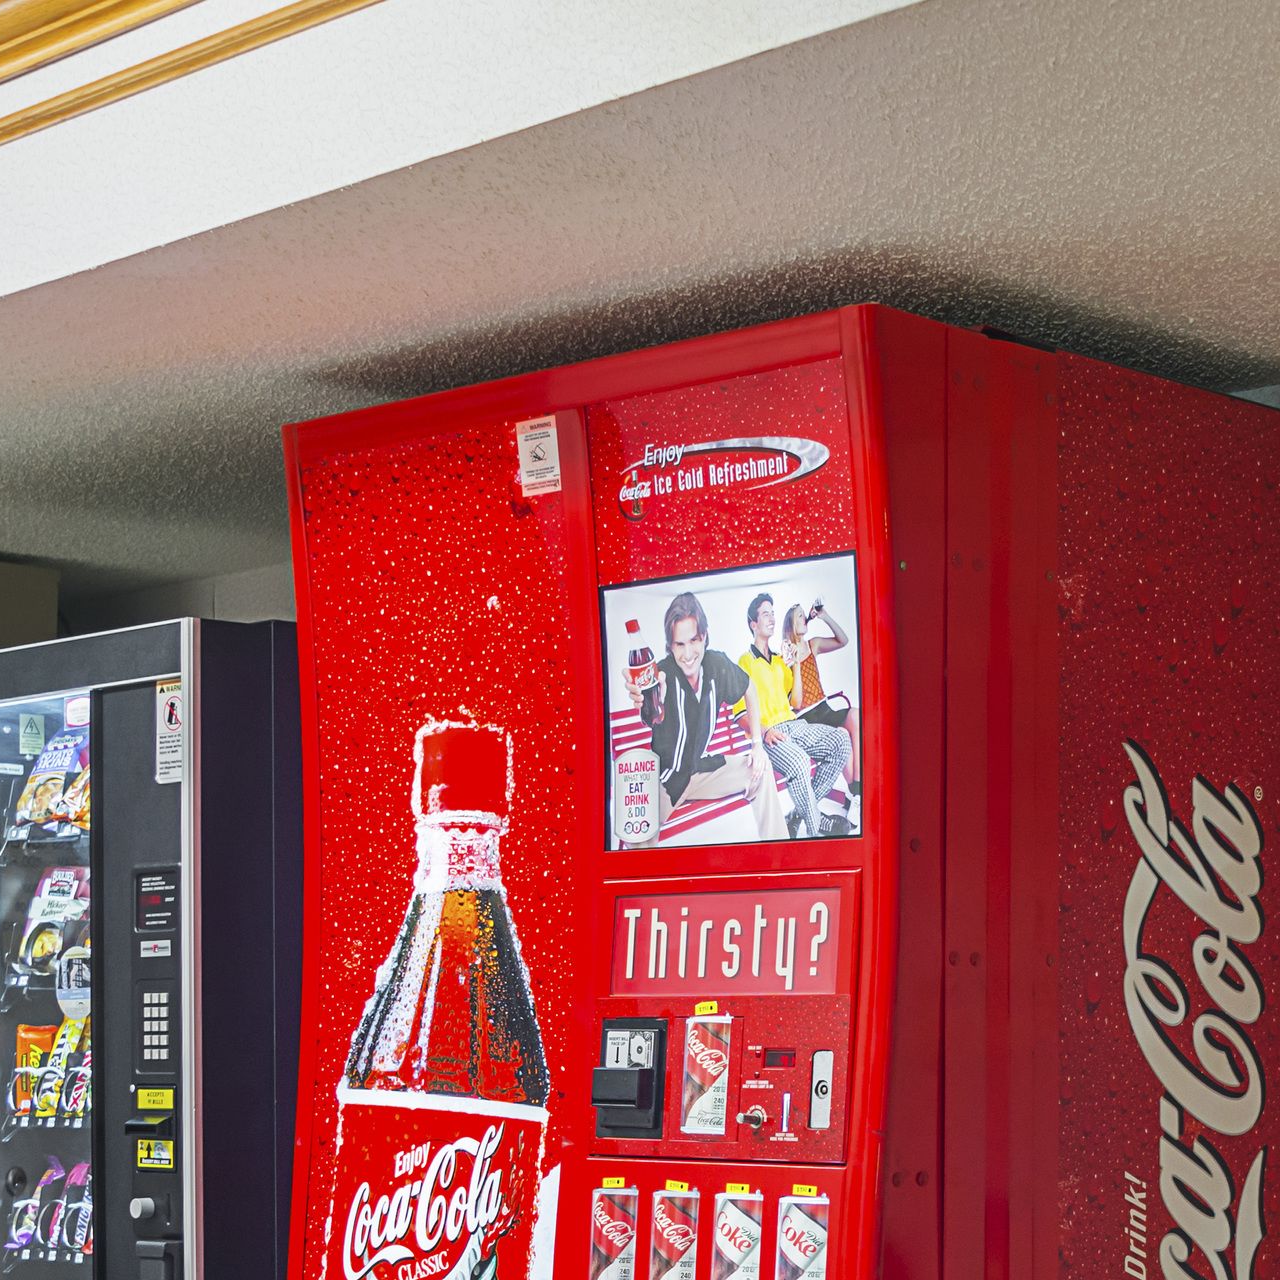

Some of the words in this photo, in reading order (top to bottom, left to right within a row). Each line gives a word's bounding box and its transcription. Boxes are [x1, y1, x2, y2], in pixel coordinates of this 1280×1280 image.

[644, 444, 685, 468] Enjoy
[654, 474, 672, 495] Ice
[677, 466, 704, 491] Cold
[709, 452, 789, 486] Refreshment
[618, 760, 656, 774] BALANCE
[640, 773, 651, 781] YOU
[624, 794, 650, 806] DRINK
[629, 782, 644, 794] EAT
[627, 807, 633, 818] &
[634, 806, 646, 818] DO
[624, 902, 830, 991] Thirsty?
[687, 1030, 728, 1076] Coca-Cola
[394, 1141, 430, 1179] Enjoy
[593, 1201, 636, 1248] Coca-Cola
[654, 1204, 697, 1251] Coca-Cola
[717, 1210, 752, 1253] Coke
[781, 1215, 817, 1258] Coke
